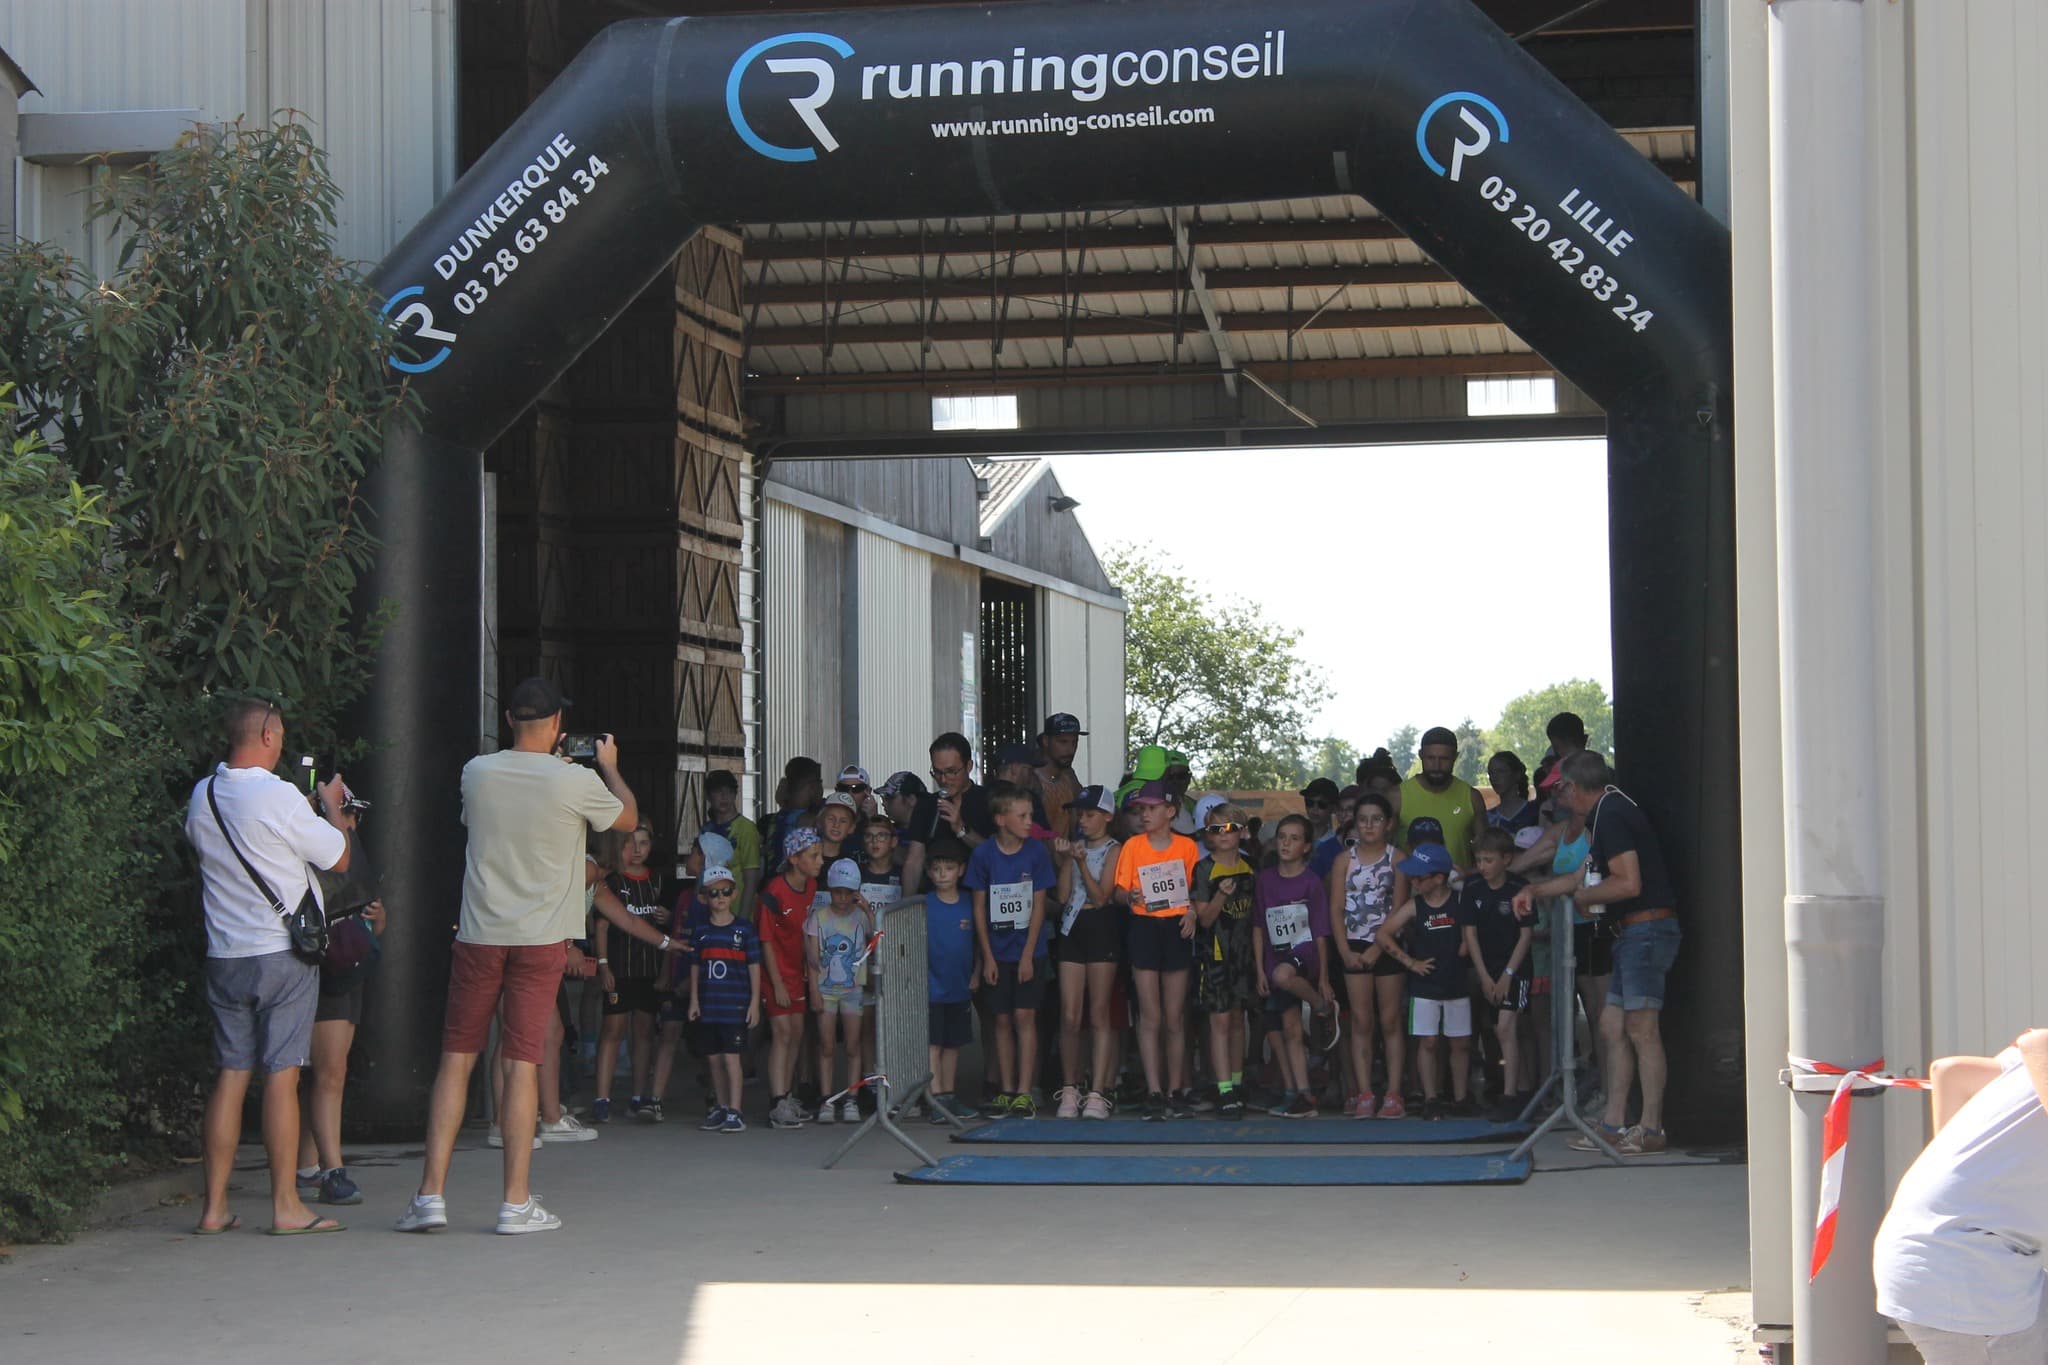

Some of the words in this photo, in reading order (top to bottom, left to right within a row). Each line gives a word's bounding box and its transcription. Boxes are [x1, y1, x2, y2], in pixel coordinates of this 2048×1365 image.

[861, 30, 1286, 102] runningconseil
[930, 105, 1215, 138] www.running-conseil.com
[433, 132, 577, 281] DUNKERQUE
[1558, 188, 1634, 257] LILLE
[453, 279, 488, 315] 03
[482, 248, 519, 287] 28
[515, 218, 549, 254] 63
[543, 186, 580, 224] 84
[571, 154, 610, 194] 34
[1479, 175, 1517, 212] 03
[1510, 204, 1551, 242] 20
[1547, 237, 1585, 274] 42
[1580, 264, 1618, 302] 83
[1612, 293, 1654, 333] 24
[1000, 901, 1022, 914] 603
[1152, 879, 1175, 894] 605
[1275, 922, 1297, 937] 611
[708, 960, 727, 979] 10
